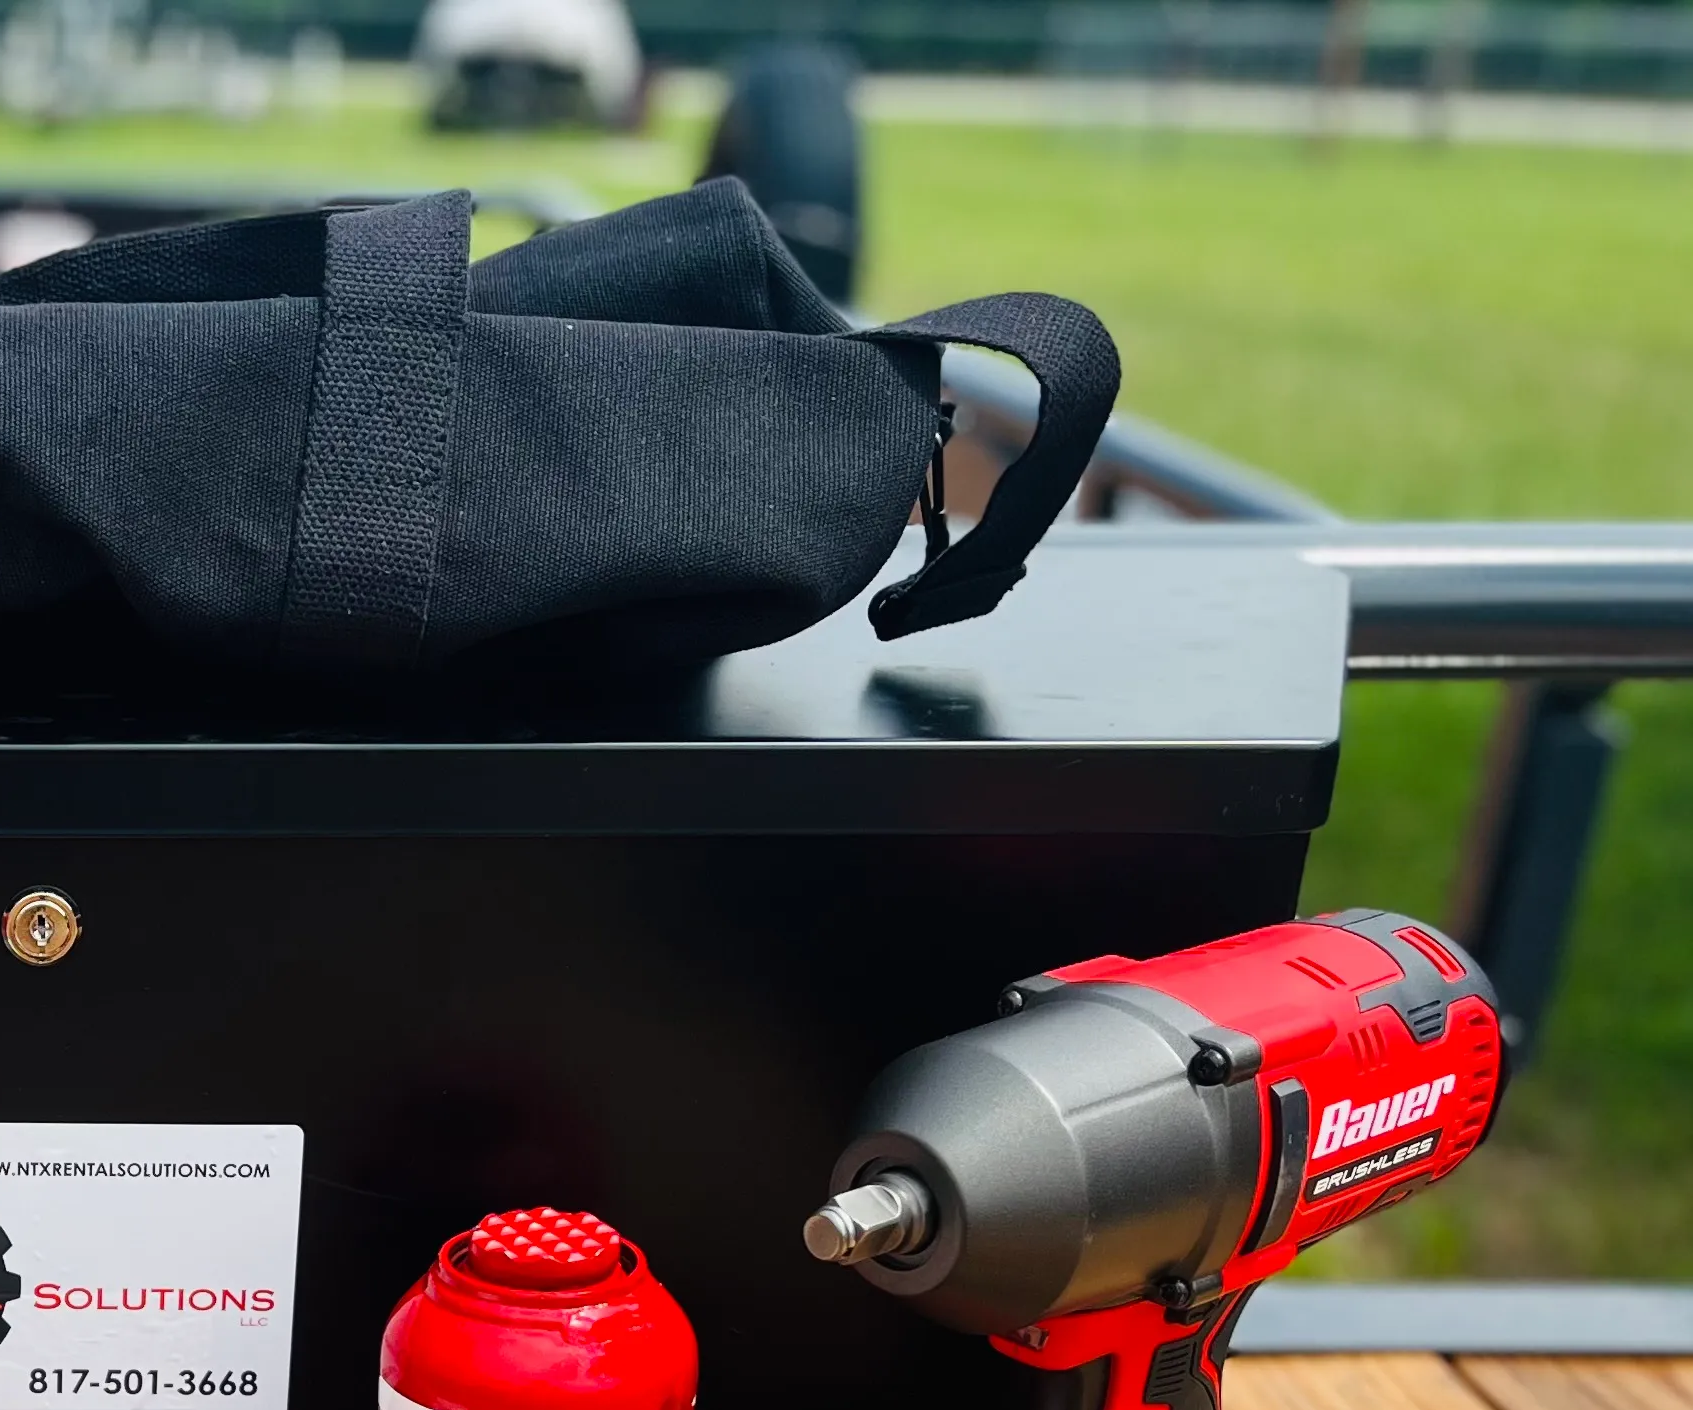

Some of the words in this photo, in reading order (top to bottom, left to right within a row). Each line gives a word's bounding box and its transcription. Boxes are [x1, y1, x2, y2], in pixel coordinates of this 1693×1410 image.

[1311, 1073, 1456, 1160] Bauer
[1313, 1136, 1434, 1196] BRUSHLESS
[33, 1283, 275, 1312] SOLUTIONS
[240, 1317, 269, 1327] LLC
[28, 1368, 258, 1397] 817-501-3668
